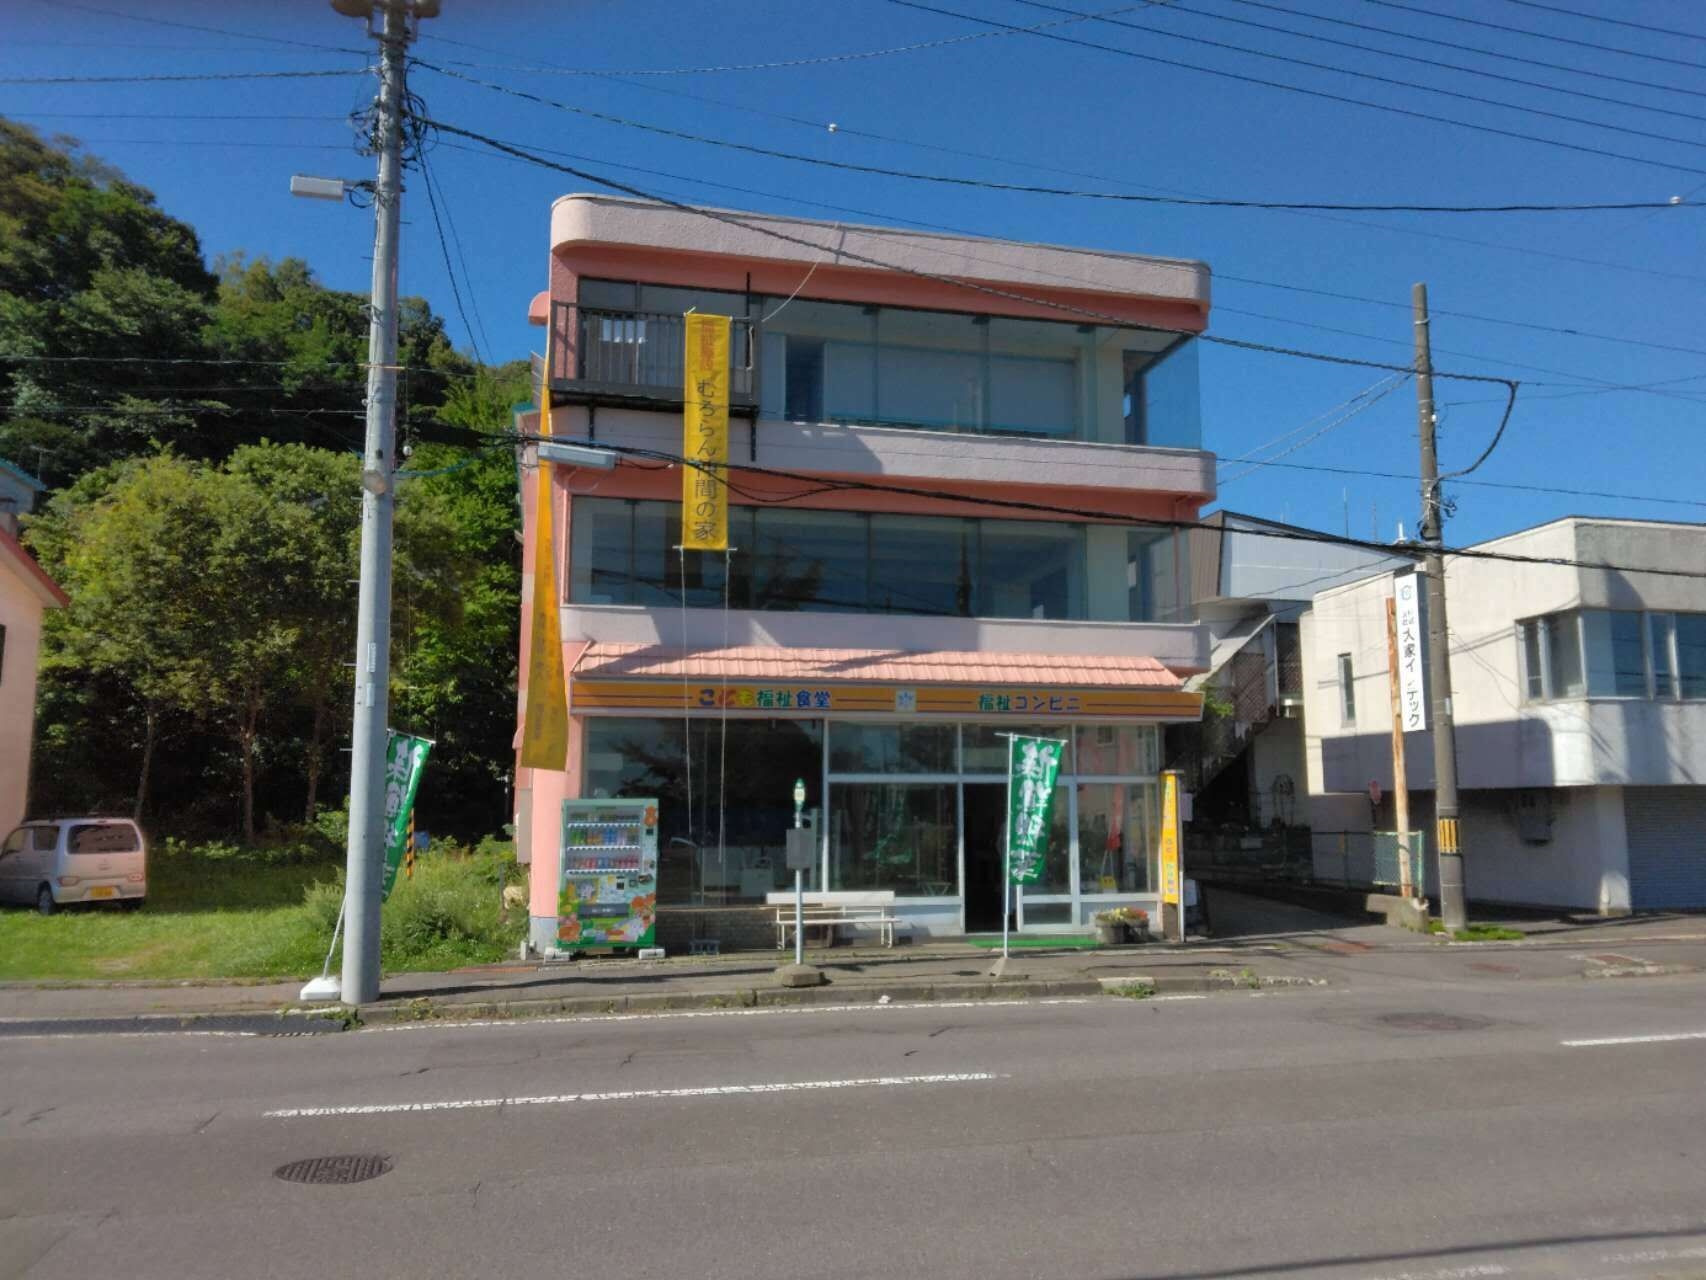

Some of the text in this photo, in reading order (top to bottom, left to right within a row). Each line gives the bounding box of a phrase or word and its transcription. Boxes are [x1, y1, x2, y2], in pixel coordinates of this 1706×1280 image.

[979, 693, 1081, 711] 福祉コンビニ
